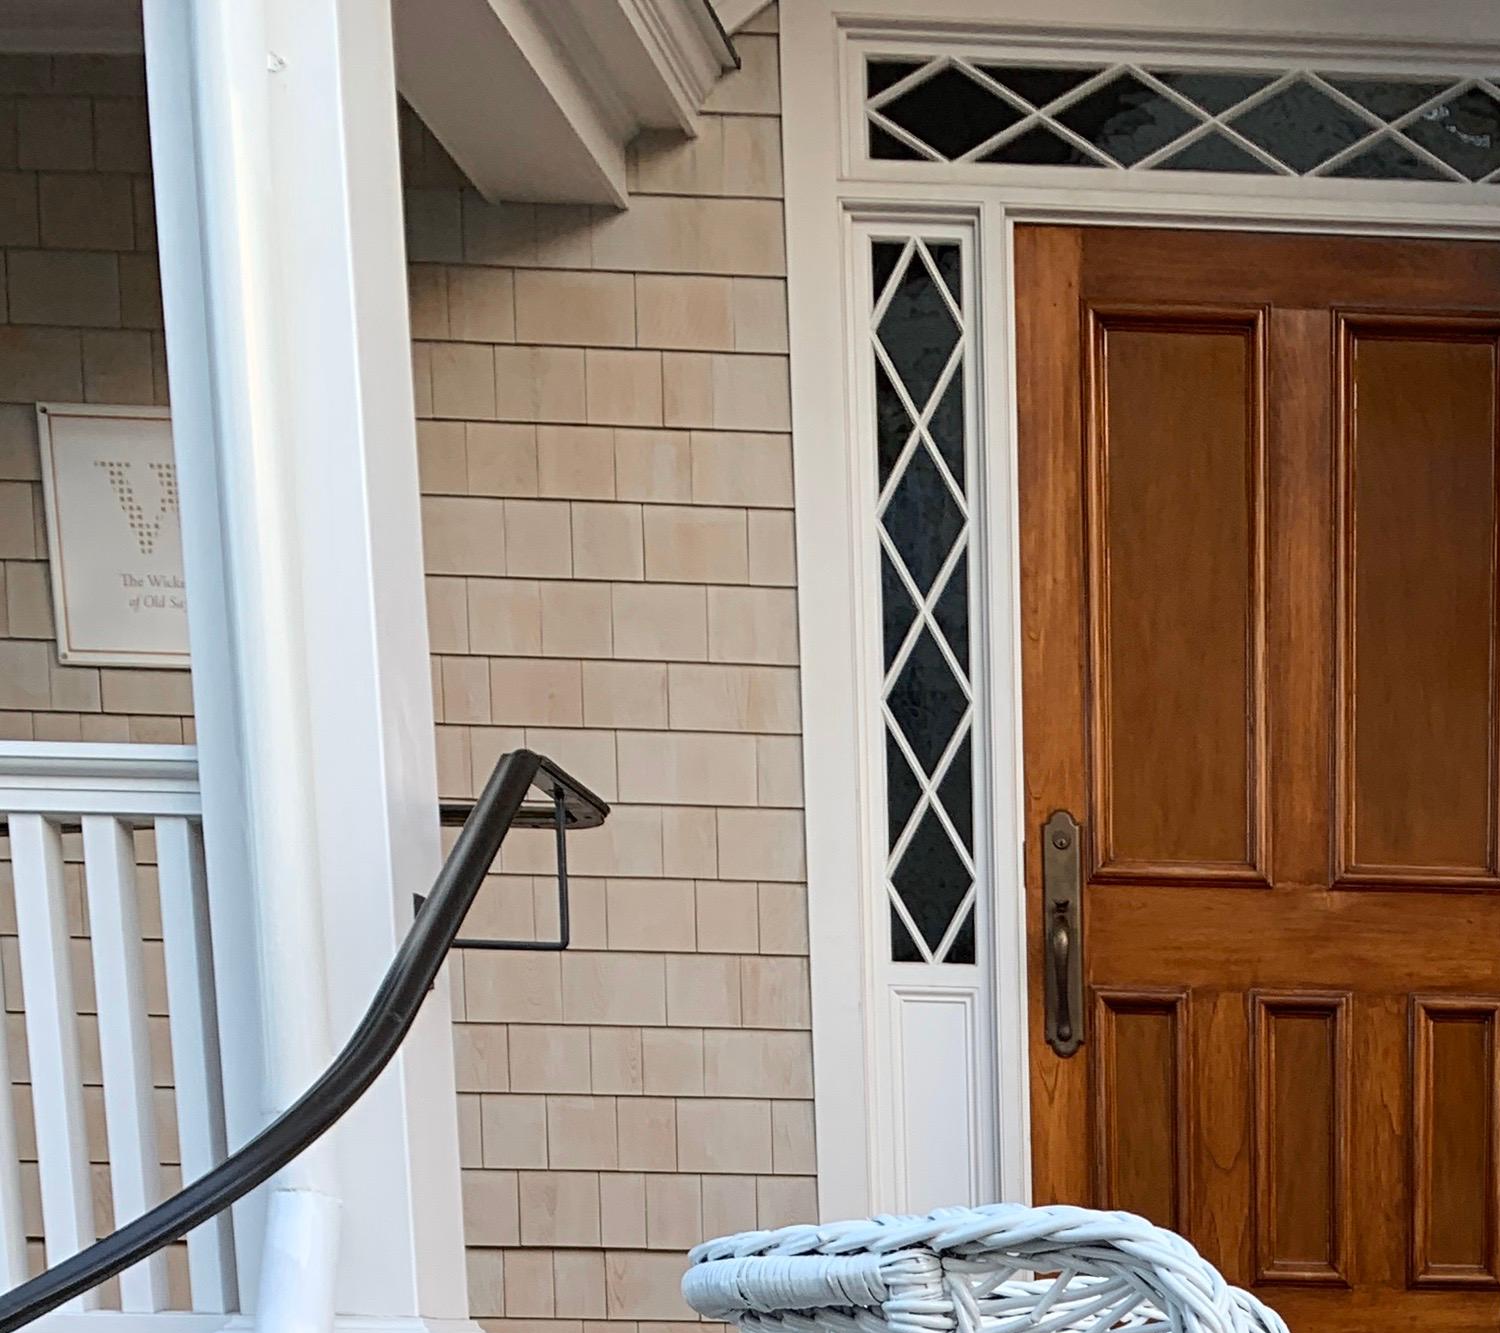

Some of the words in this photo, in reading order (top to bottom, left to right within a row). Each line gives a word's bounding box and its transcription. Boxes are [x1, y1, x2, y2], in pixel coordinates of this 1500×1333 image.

[120, 573, 144, 587] The
[129, 597, 140, 613] of
[143, 594, 166, 609] Old
